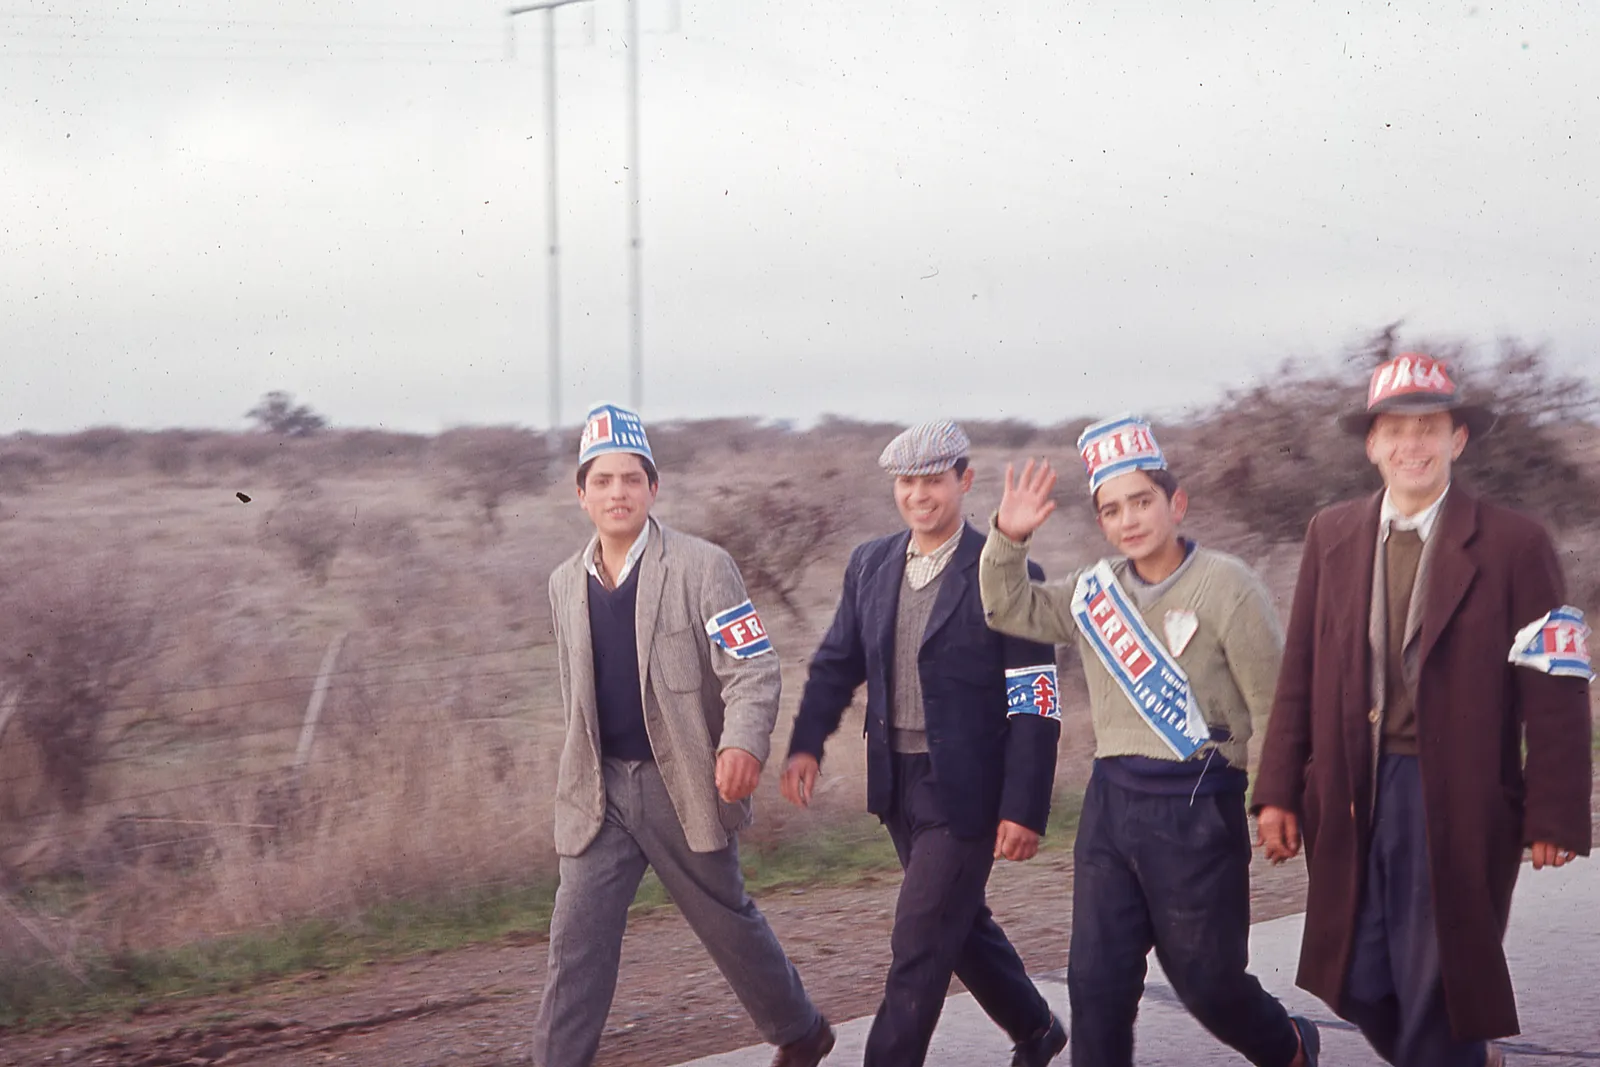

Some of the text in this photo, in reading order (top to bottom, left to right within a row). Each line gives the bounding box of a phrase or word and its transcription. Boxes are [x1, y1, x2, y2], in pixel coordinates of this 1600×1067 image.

[1086, 428, 1149, 468] FREI
[730, 616, 764, 645] FR
[1091, 600, 1143, 672] FREI
[1160, 684, 1174, 700] LA
